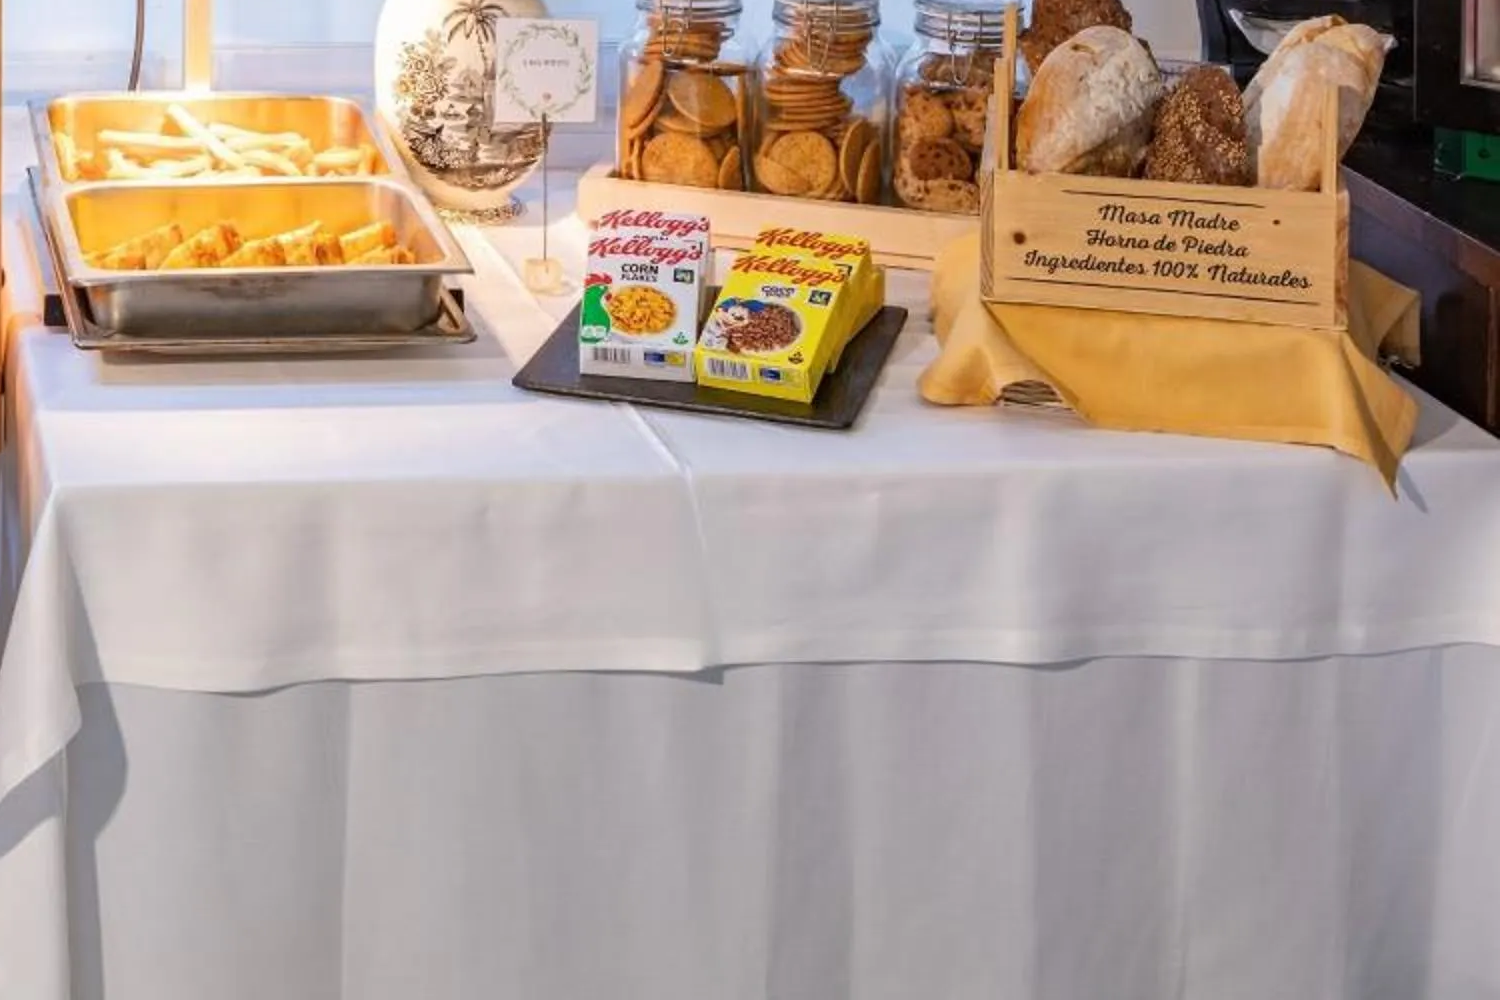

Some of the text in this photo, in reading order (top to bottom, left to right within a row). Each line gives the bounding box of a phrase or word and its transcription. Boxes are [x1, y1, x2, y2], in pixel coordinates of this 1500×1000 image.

[601, 209, 710, 236] Kellogg's
[1098, 204, 1241, 231] Masa Madre
[588, 237, 701, 265] Kellogg's
[755, 228, 868, 260] Kellogg's
[1087, 228, 1249, 258] Horno de Piedra
[621, 263, 659, 275] CORN
[731, 254, 846, 286] Kellogg's
[1024, 249, 1148, 276] Ingredientes
[1152, 259, 1199, 279] 100%
